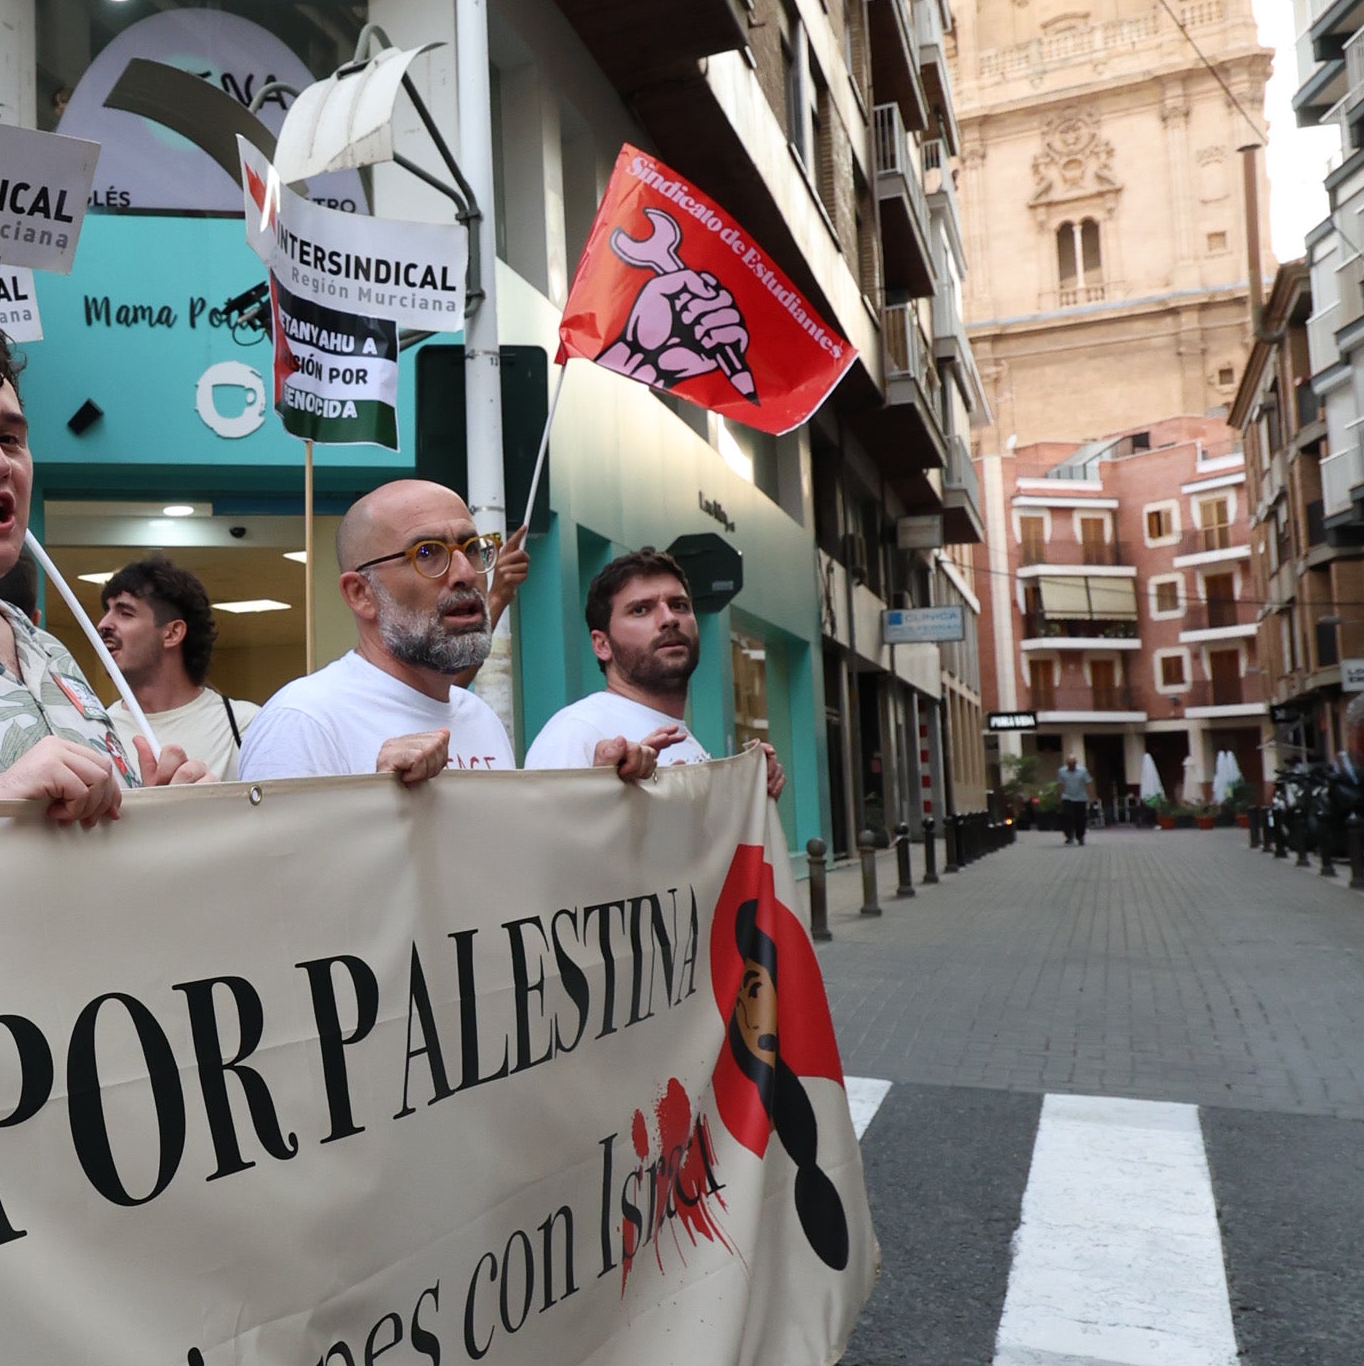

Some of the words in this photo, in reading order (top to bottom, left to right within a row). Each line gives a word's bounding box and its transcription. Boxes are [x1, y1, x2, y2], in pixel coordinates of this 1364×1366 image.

[277, 220, 457, 292] INTERSINDICAL
[626, 156, 723, 232] Sindicato
[720, 227, 746, 255] de
[741, 246, 844, 359] Estudiantes
[84, 294, 178, 328] Mama
[291, 266, 349, 298] Región
[358, 286, 457, 312] Murciana
[279, 302, 355, 353] ETANYAHU
[362, 337, 378, 355] A
[291, 354, 323, 381] SIÓN
[329, 368, 369, 385] POR
[295, 884, 700, 1145] PALESTINA
[463, 1205, 580, 1360] con
